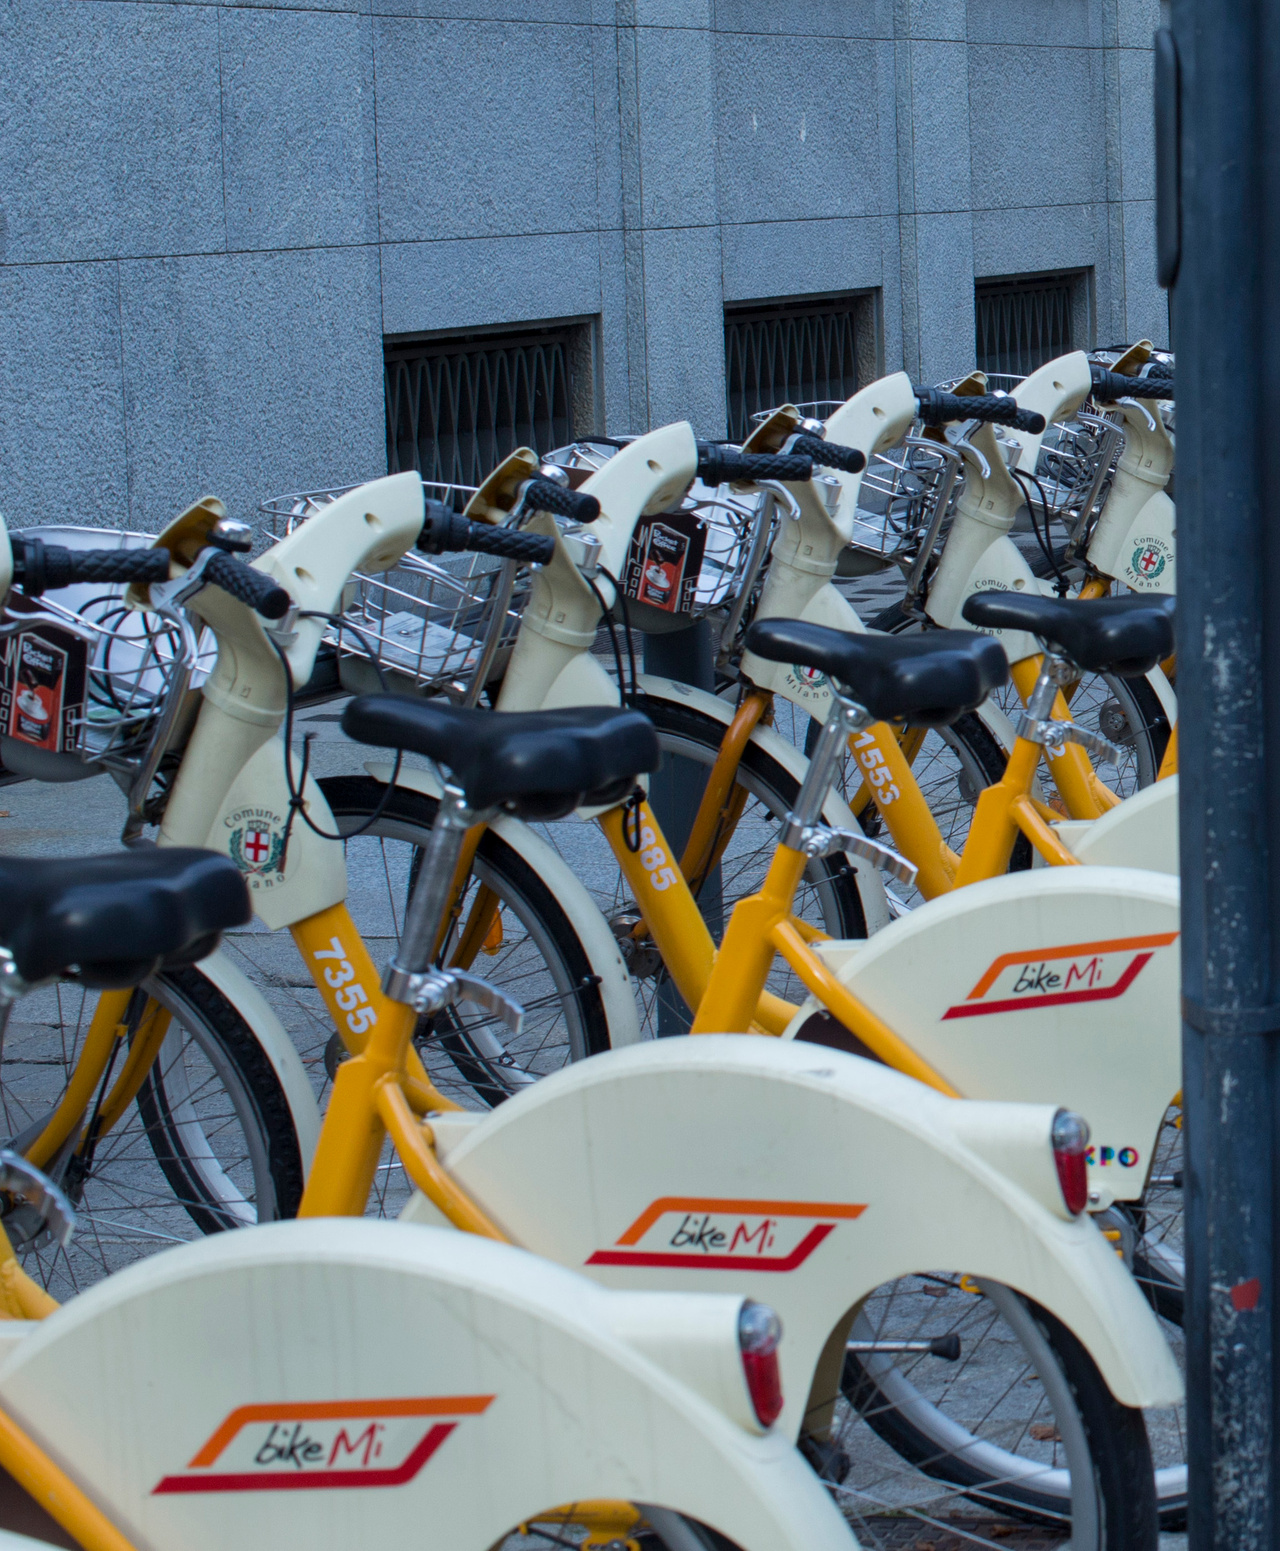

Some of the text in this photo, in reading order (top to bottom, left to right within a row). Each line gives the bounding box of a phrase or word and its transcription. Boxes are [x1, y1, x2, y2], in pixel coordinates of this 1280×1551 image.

[1133, 536, 1175, 563] Comune di
[974, 579, 1010, 592] Comun
[1125, 566, 1161, 588] Milano
[785, 674, 829, 699] Milano
[854, 731, 901, 805] 1553
[224, 808, 282, 829] Comune
[313, 936, 378, 1034] 7355
[1012, 956, 1104, 993] bikeMi
[1084, 1145, 1139, 1168] XPO
[670, 1213, 777, 1254] bikeMi
[254, 1421, 386, 1468] bikeMi
